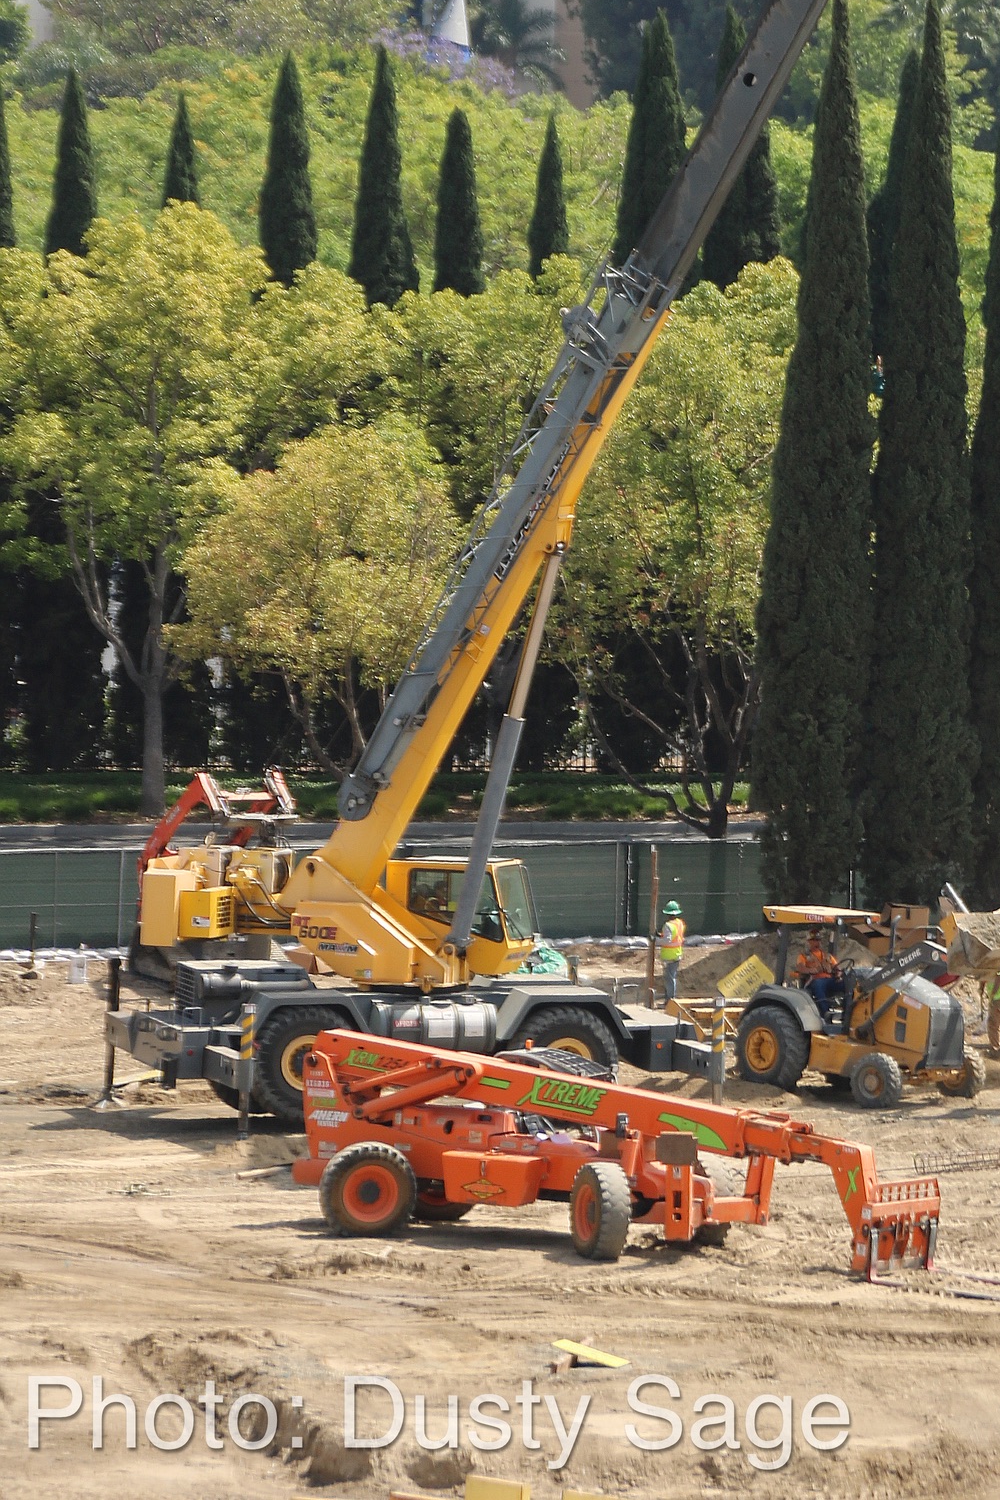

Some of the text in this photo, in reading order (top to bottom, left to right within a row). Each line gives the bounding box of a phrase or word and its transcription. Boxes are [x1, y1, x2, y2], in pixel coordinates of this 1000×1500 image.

[298, 925, 338, 940] 600E
[898, 947, 922, 968] DEERE
[516, 1076, 607, 1112] XTREME
[308, 1109, 349, 1123] AHERN
